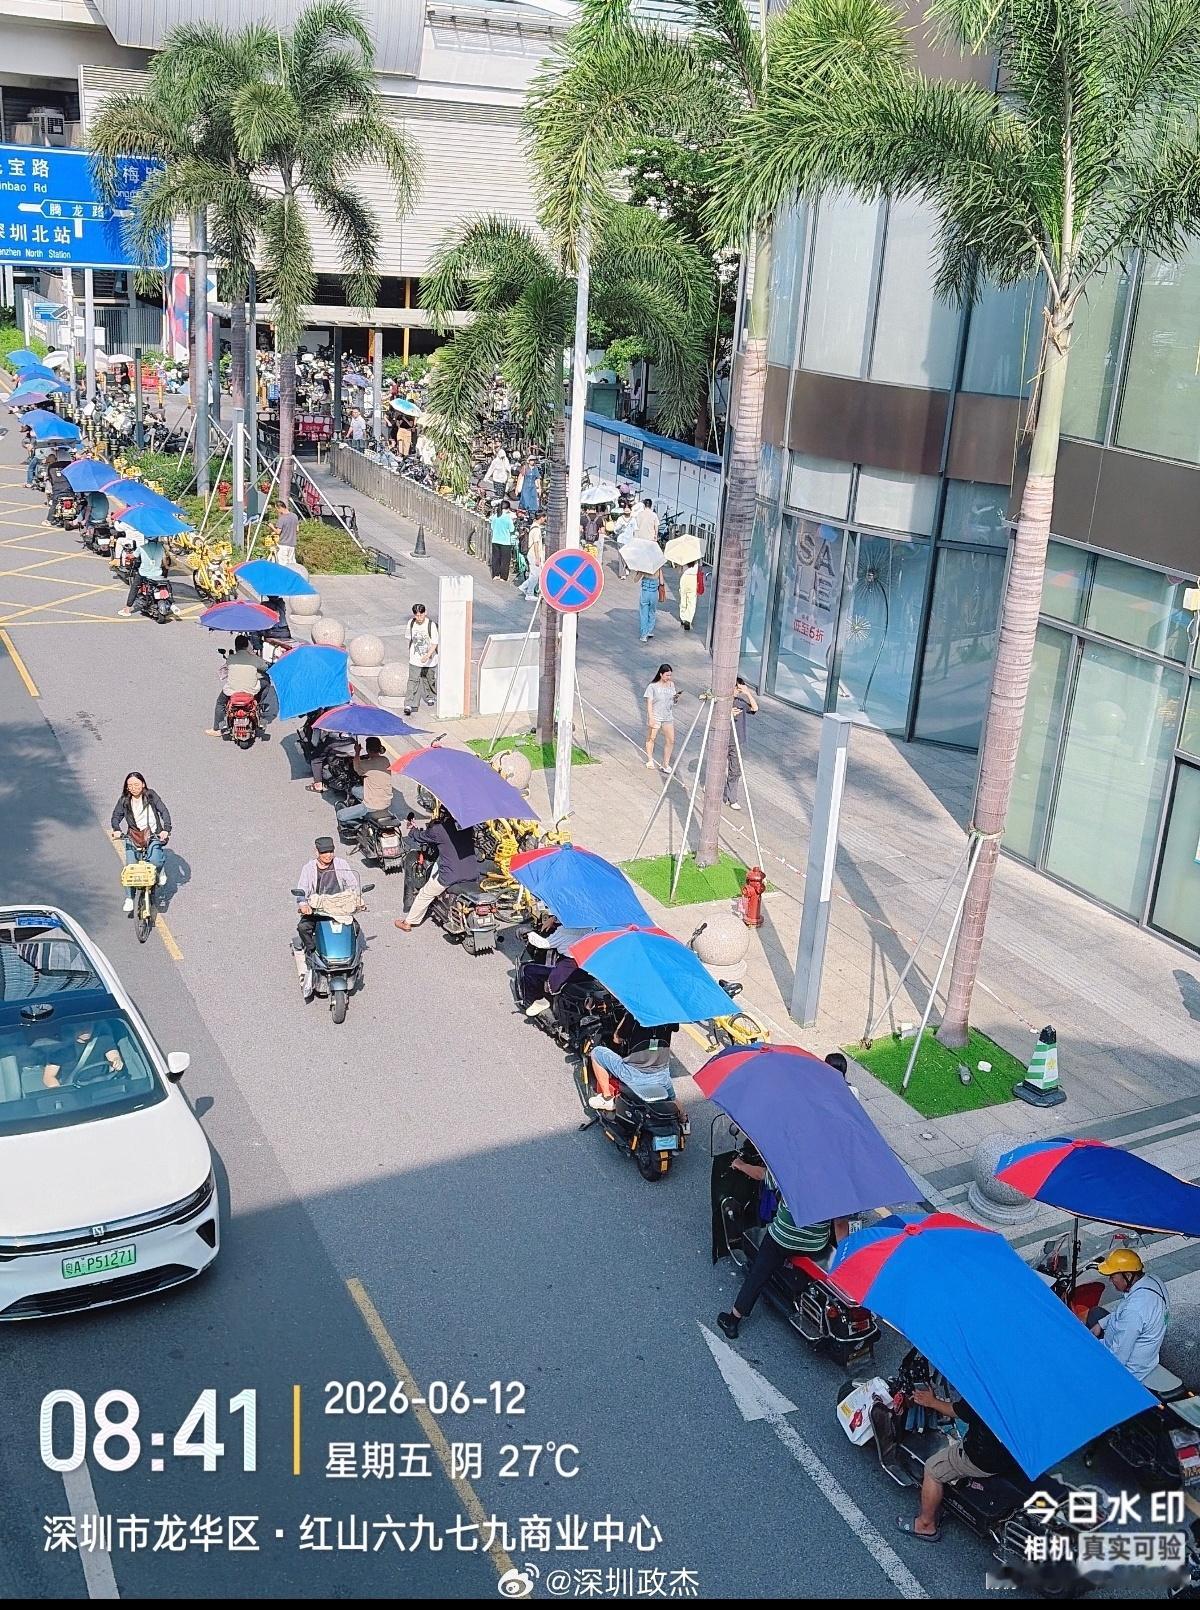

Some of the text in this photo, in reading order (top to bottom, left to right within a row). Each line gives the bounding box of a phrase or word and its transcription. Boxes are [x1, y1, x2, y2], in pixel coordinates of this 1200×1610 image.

[0, 157, 49, 178] 宝路
[33, 183, 47, 193] Rd
[50, 203, 105, 219] 腾龙路
[25, 248, 44, 258] North
[48, 249, 71, 259] Station
